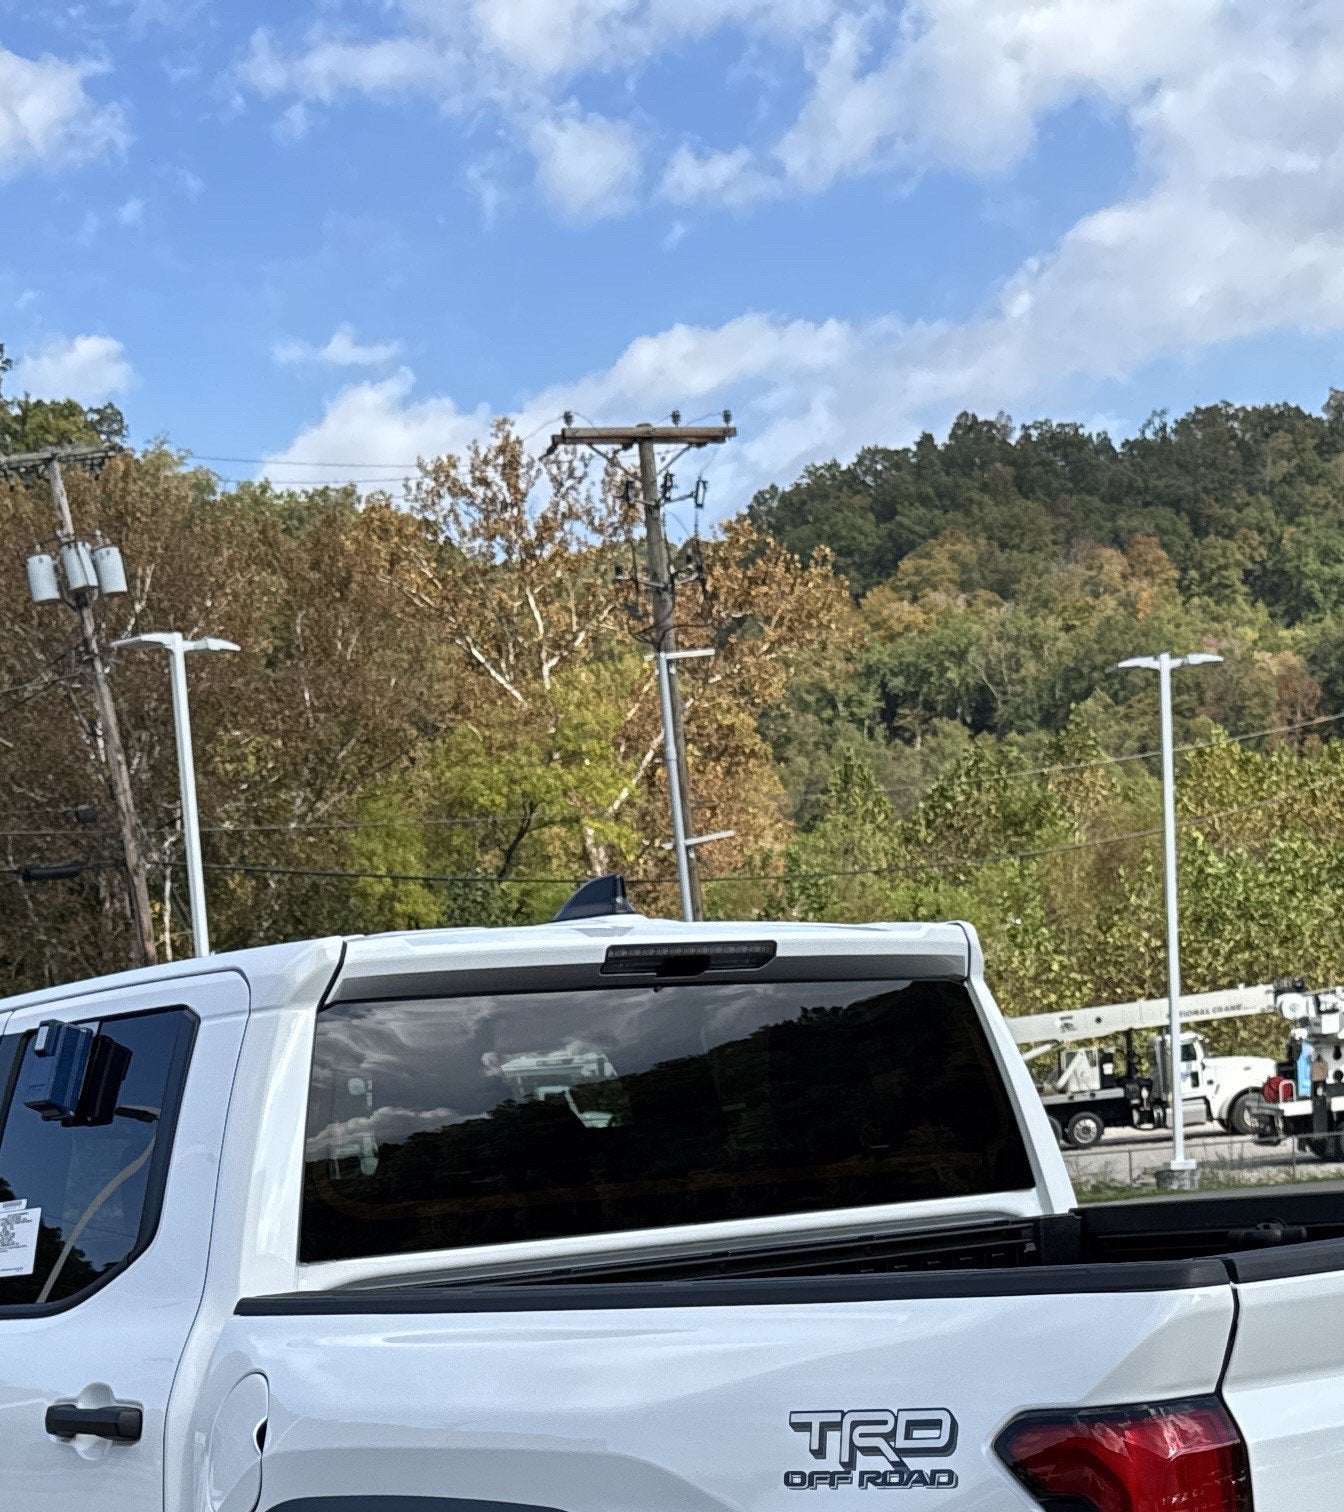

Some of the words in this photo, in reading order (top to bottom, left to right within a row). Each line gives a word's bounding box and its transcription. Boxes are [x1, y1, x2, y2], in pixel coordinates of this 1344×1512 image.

[789, 1407, 959, 1474] TRD
[783, 1470, 854, 1490] OFF
[858, 1468, 959, 1490] ROAD
